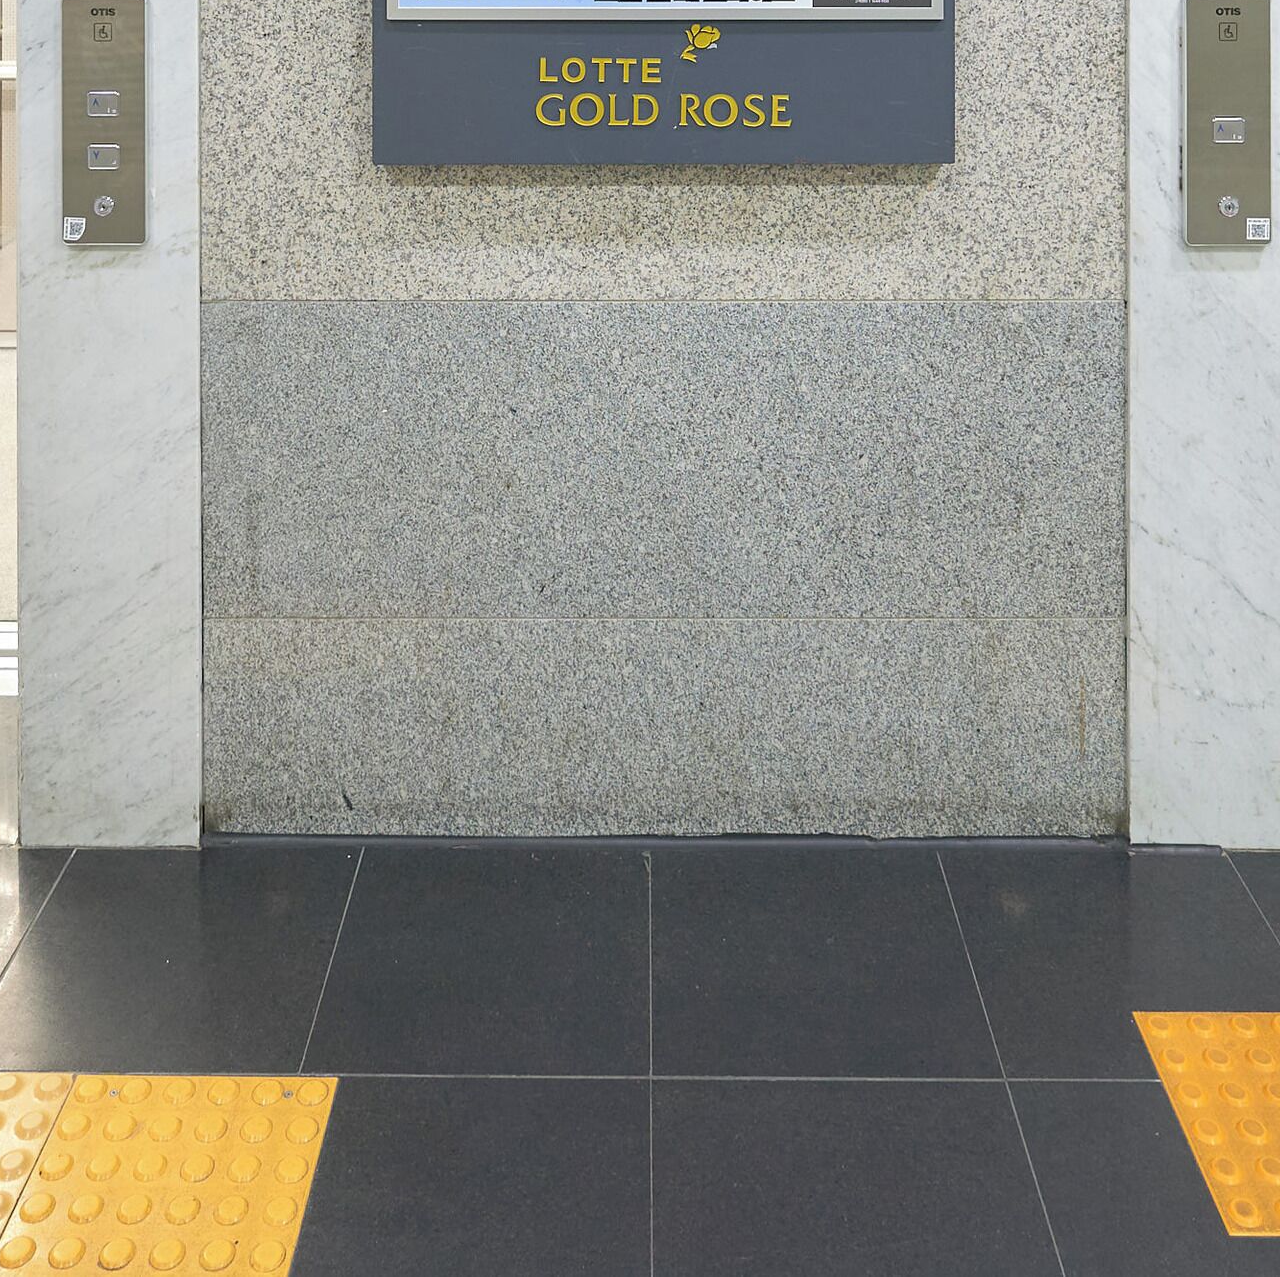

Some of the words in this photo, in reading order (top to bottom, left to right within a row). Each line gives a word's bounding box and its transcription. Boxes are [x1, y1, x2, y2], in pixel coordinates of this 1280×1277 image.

[91, 8, 115, 16] OTIS
[1216, 8, 1241, 16] OTIS
[538, 57, 662, 83] LOTTE
[535, 92, 660, 127] GOLD
[678, 93, 792, 127] ROSE
